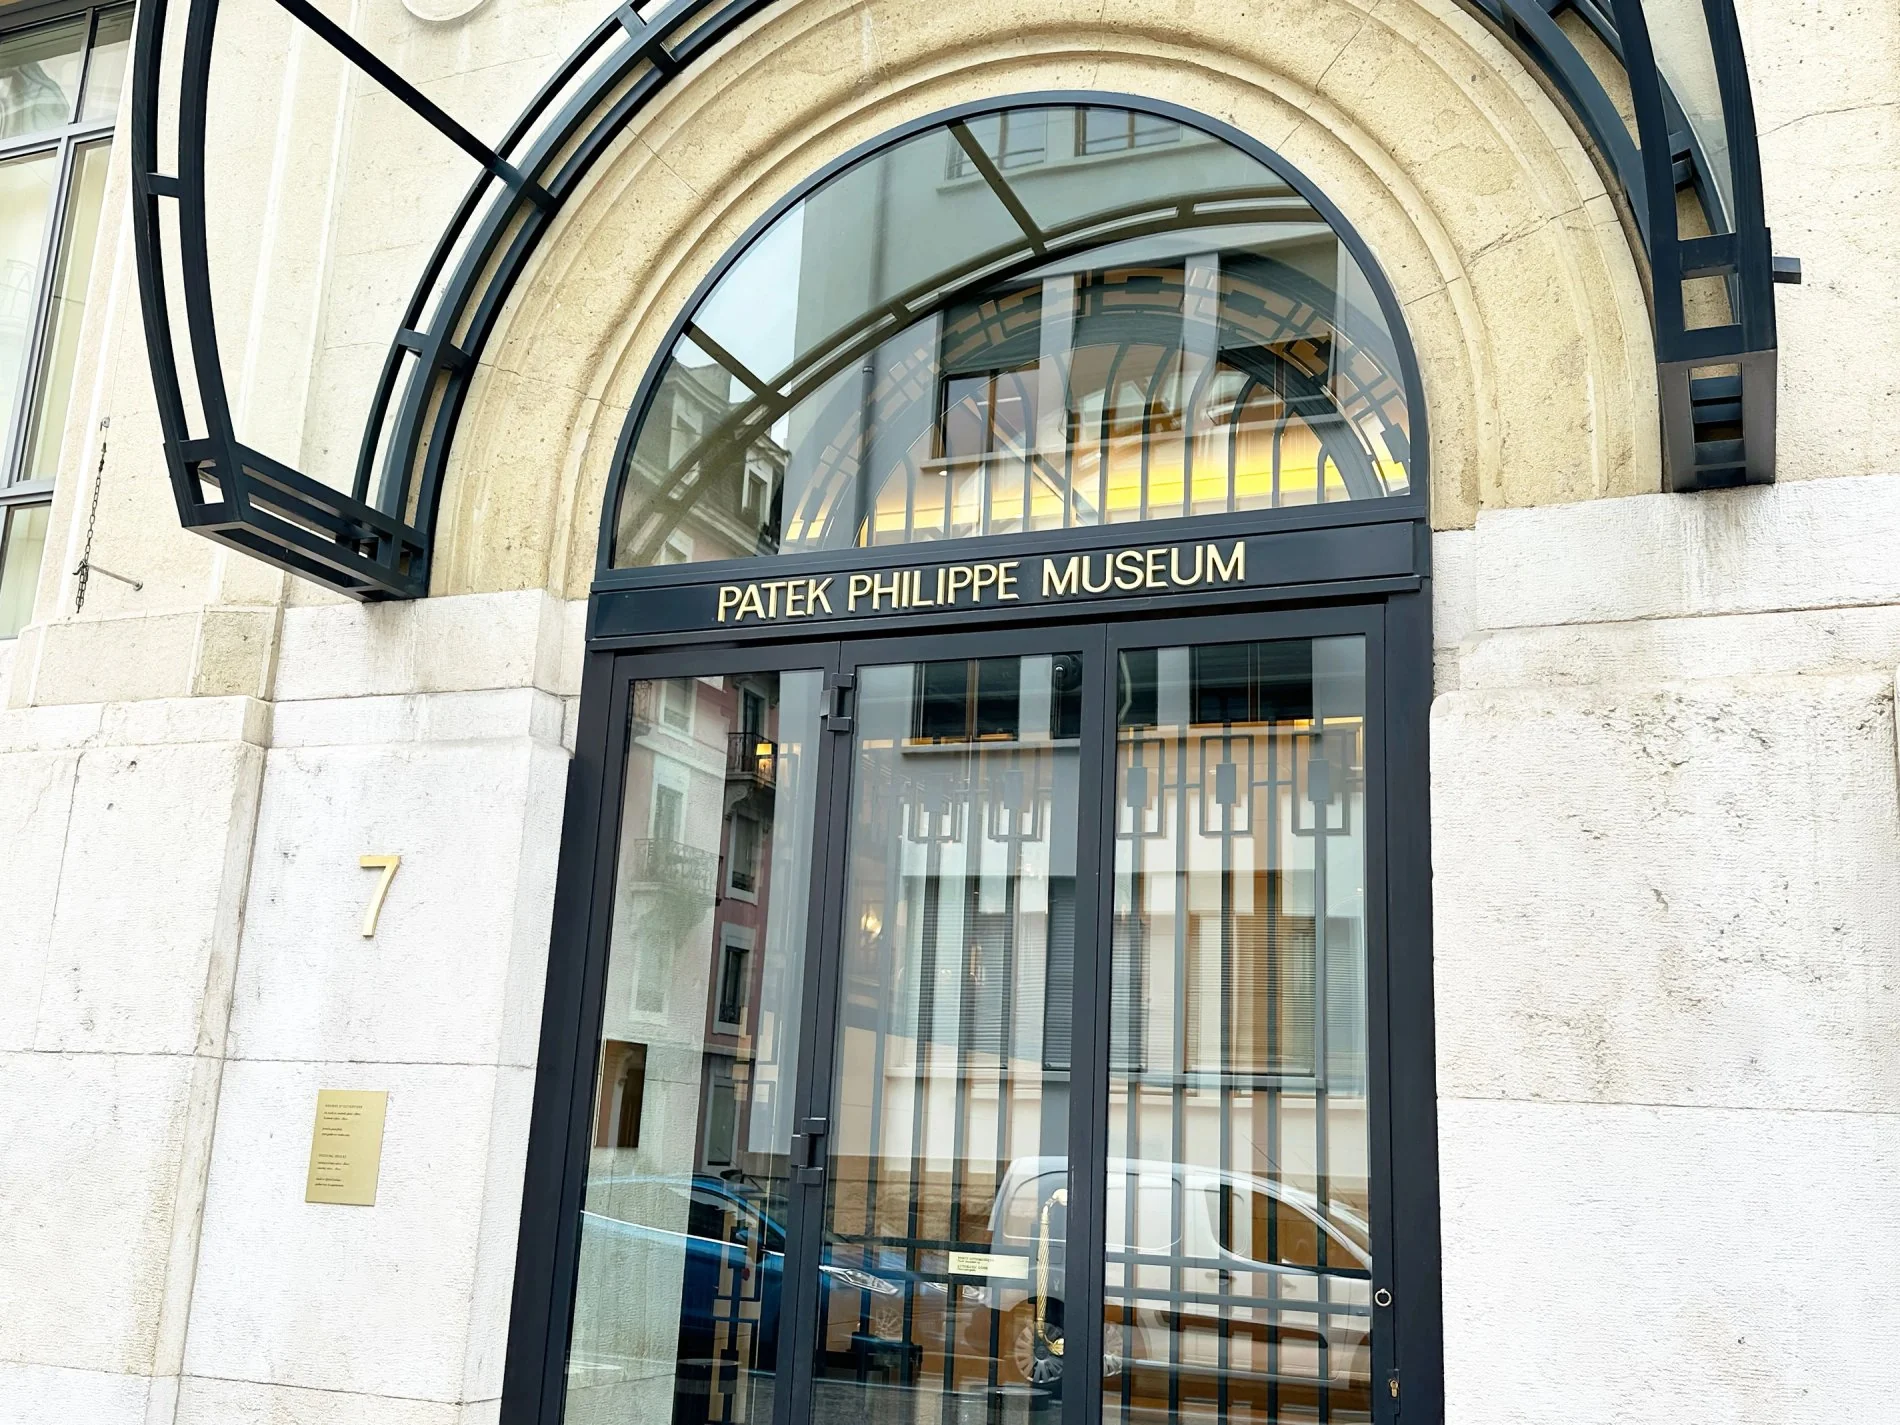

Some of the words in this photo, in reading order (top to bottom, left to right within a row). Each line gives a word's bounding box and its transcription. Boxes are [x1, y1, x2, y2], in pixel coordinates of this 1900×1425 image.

[717, 577, 834, 623] PATEK
[848, 561, 1020, 612] PHILIPPE
[1041, 541, 1245, 597] MUSEUM
[360, 855, 401, 938] 7
